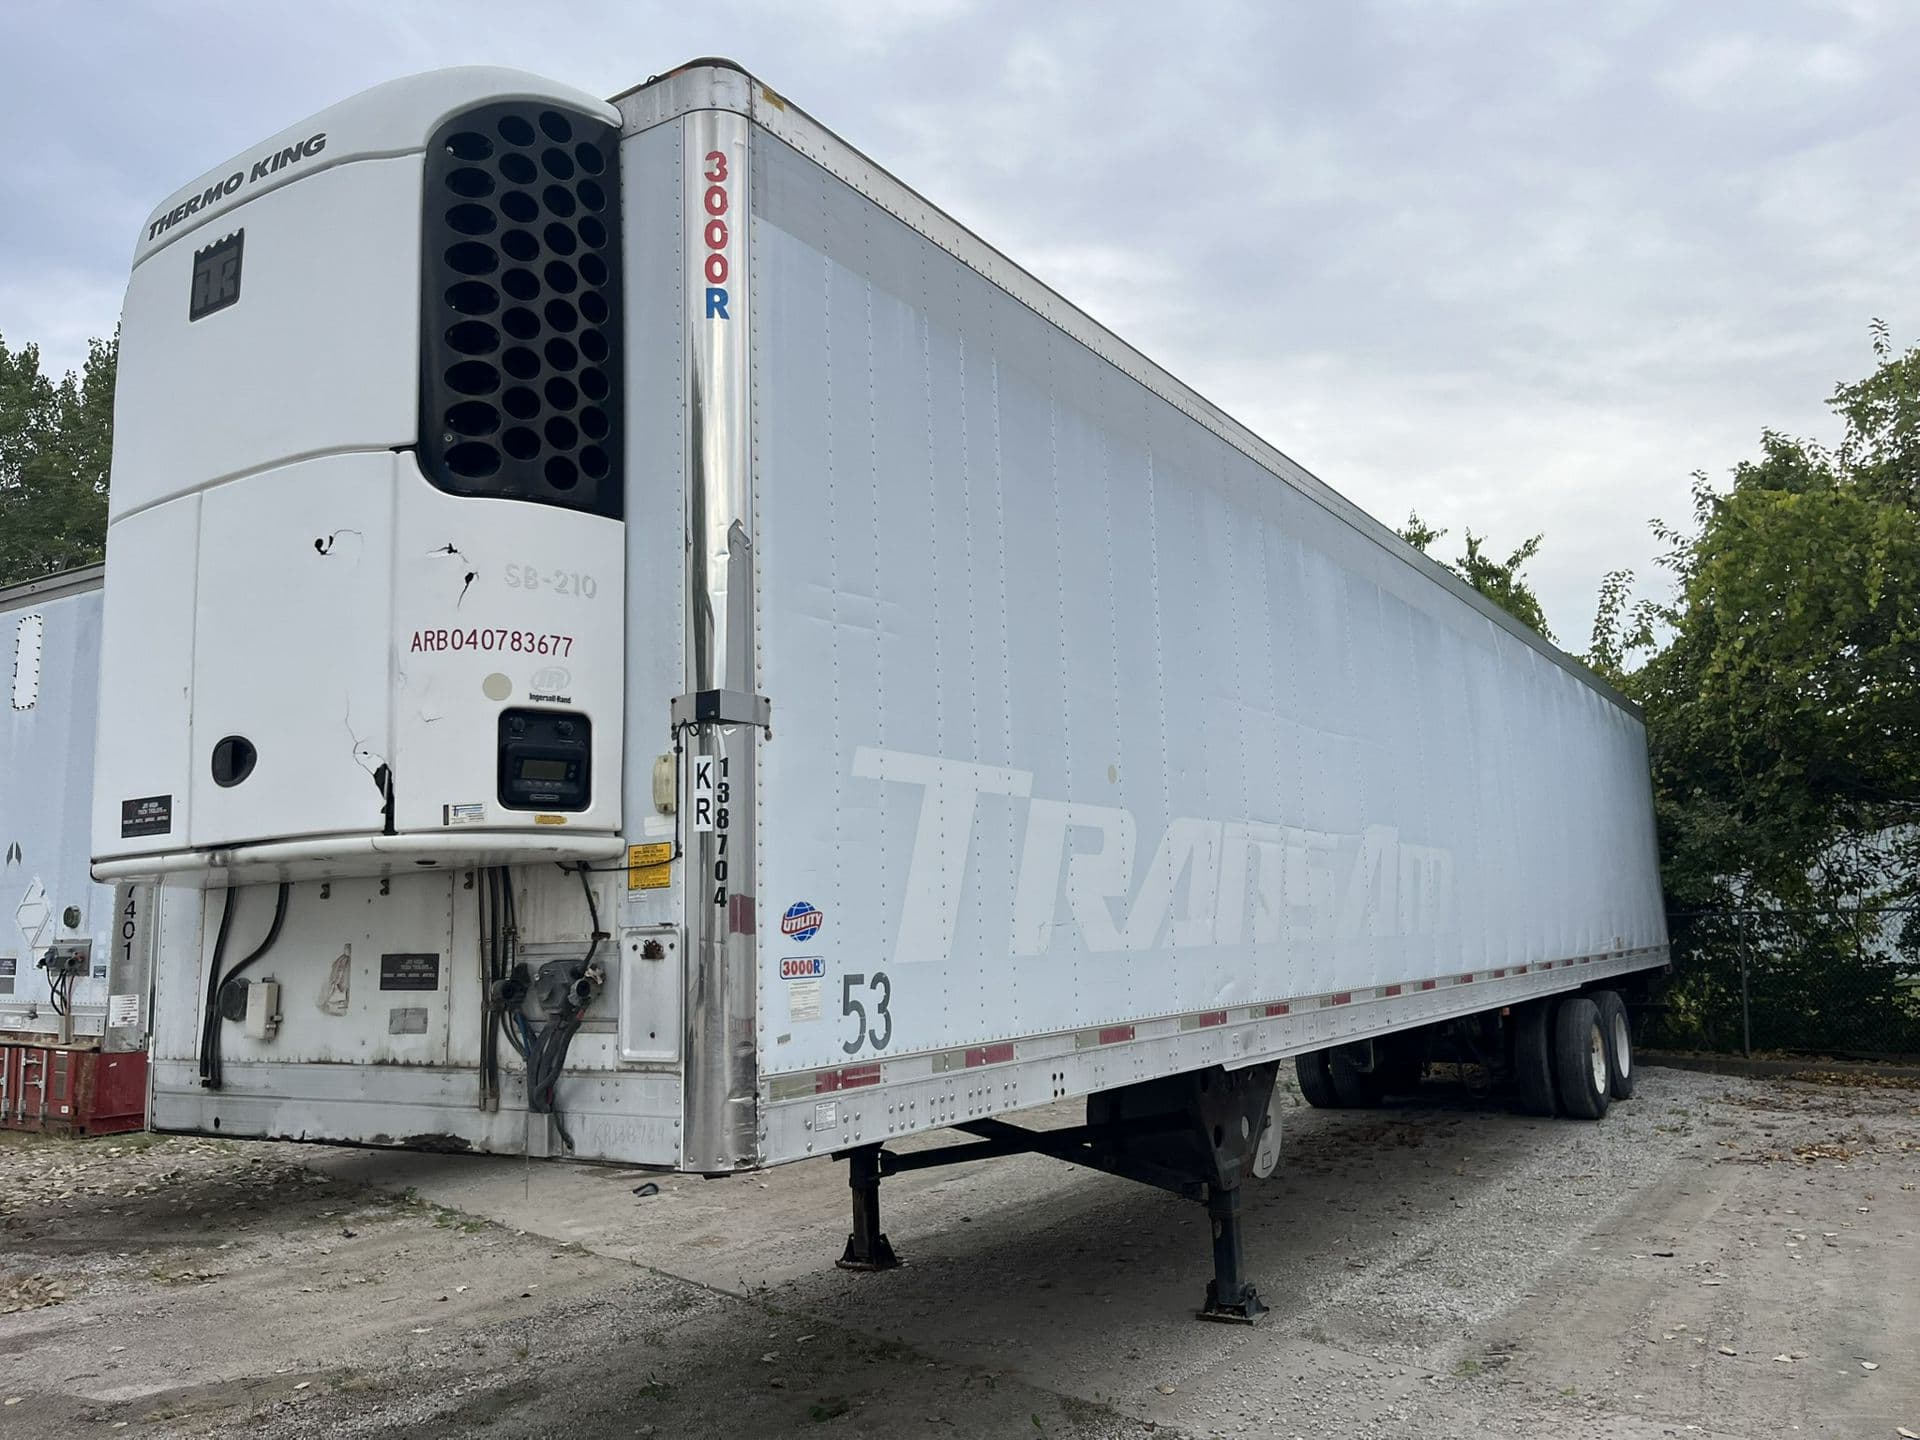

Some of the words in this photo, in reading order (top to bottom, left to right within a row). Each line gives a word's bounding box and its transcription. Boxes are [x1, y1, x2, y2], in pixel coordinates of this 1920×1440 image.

[148, 171, 245, 242] THERMO
[249, 132, 327, 184] KING
[703, 150, 730, 321] 3000R
[503, 563, 597, 599] SB-210
[410, 628, 574, 658] ARB040783677
[714, 757, 730, 908] 138704
[783, 912, 823, 932] UTILITY
[782, 958, 821, 977] 3000R
[841, 971, 892, 1055] 53
